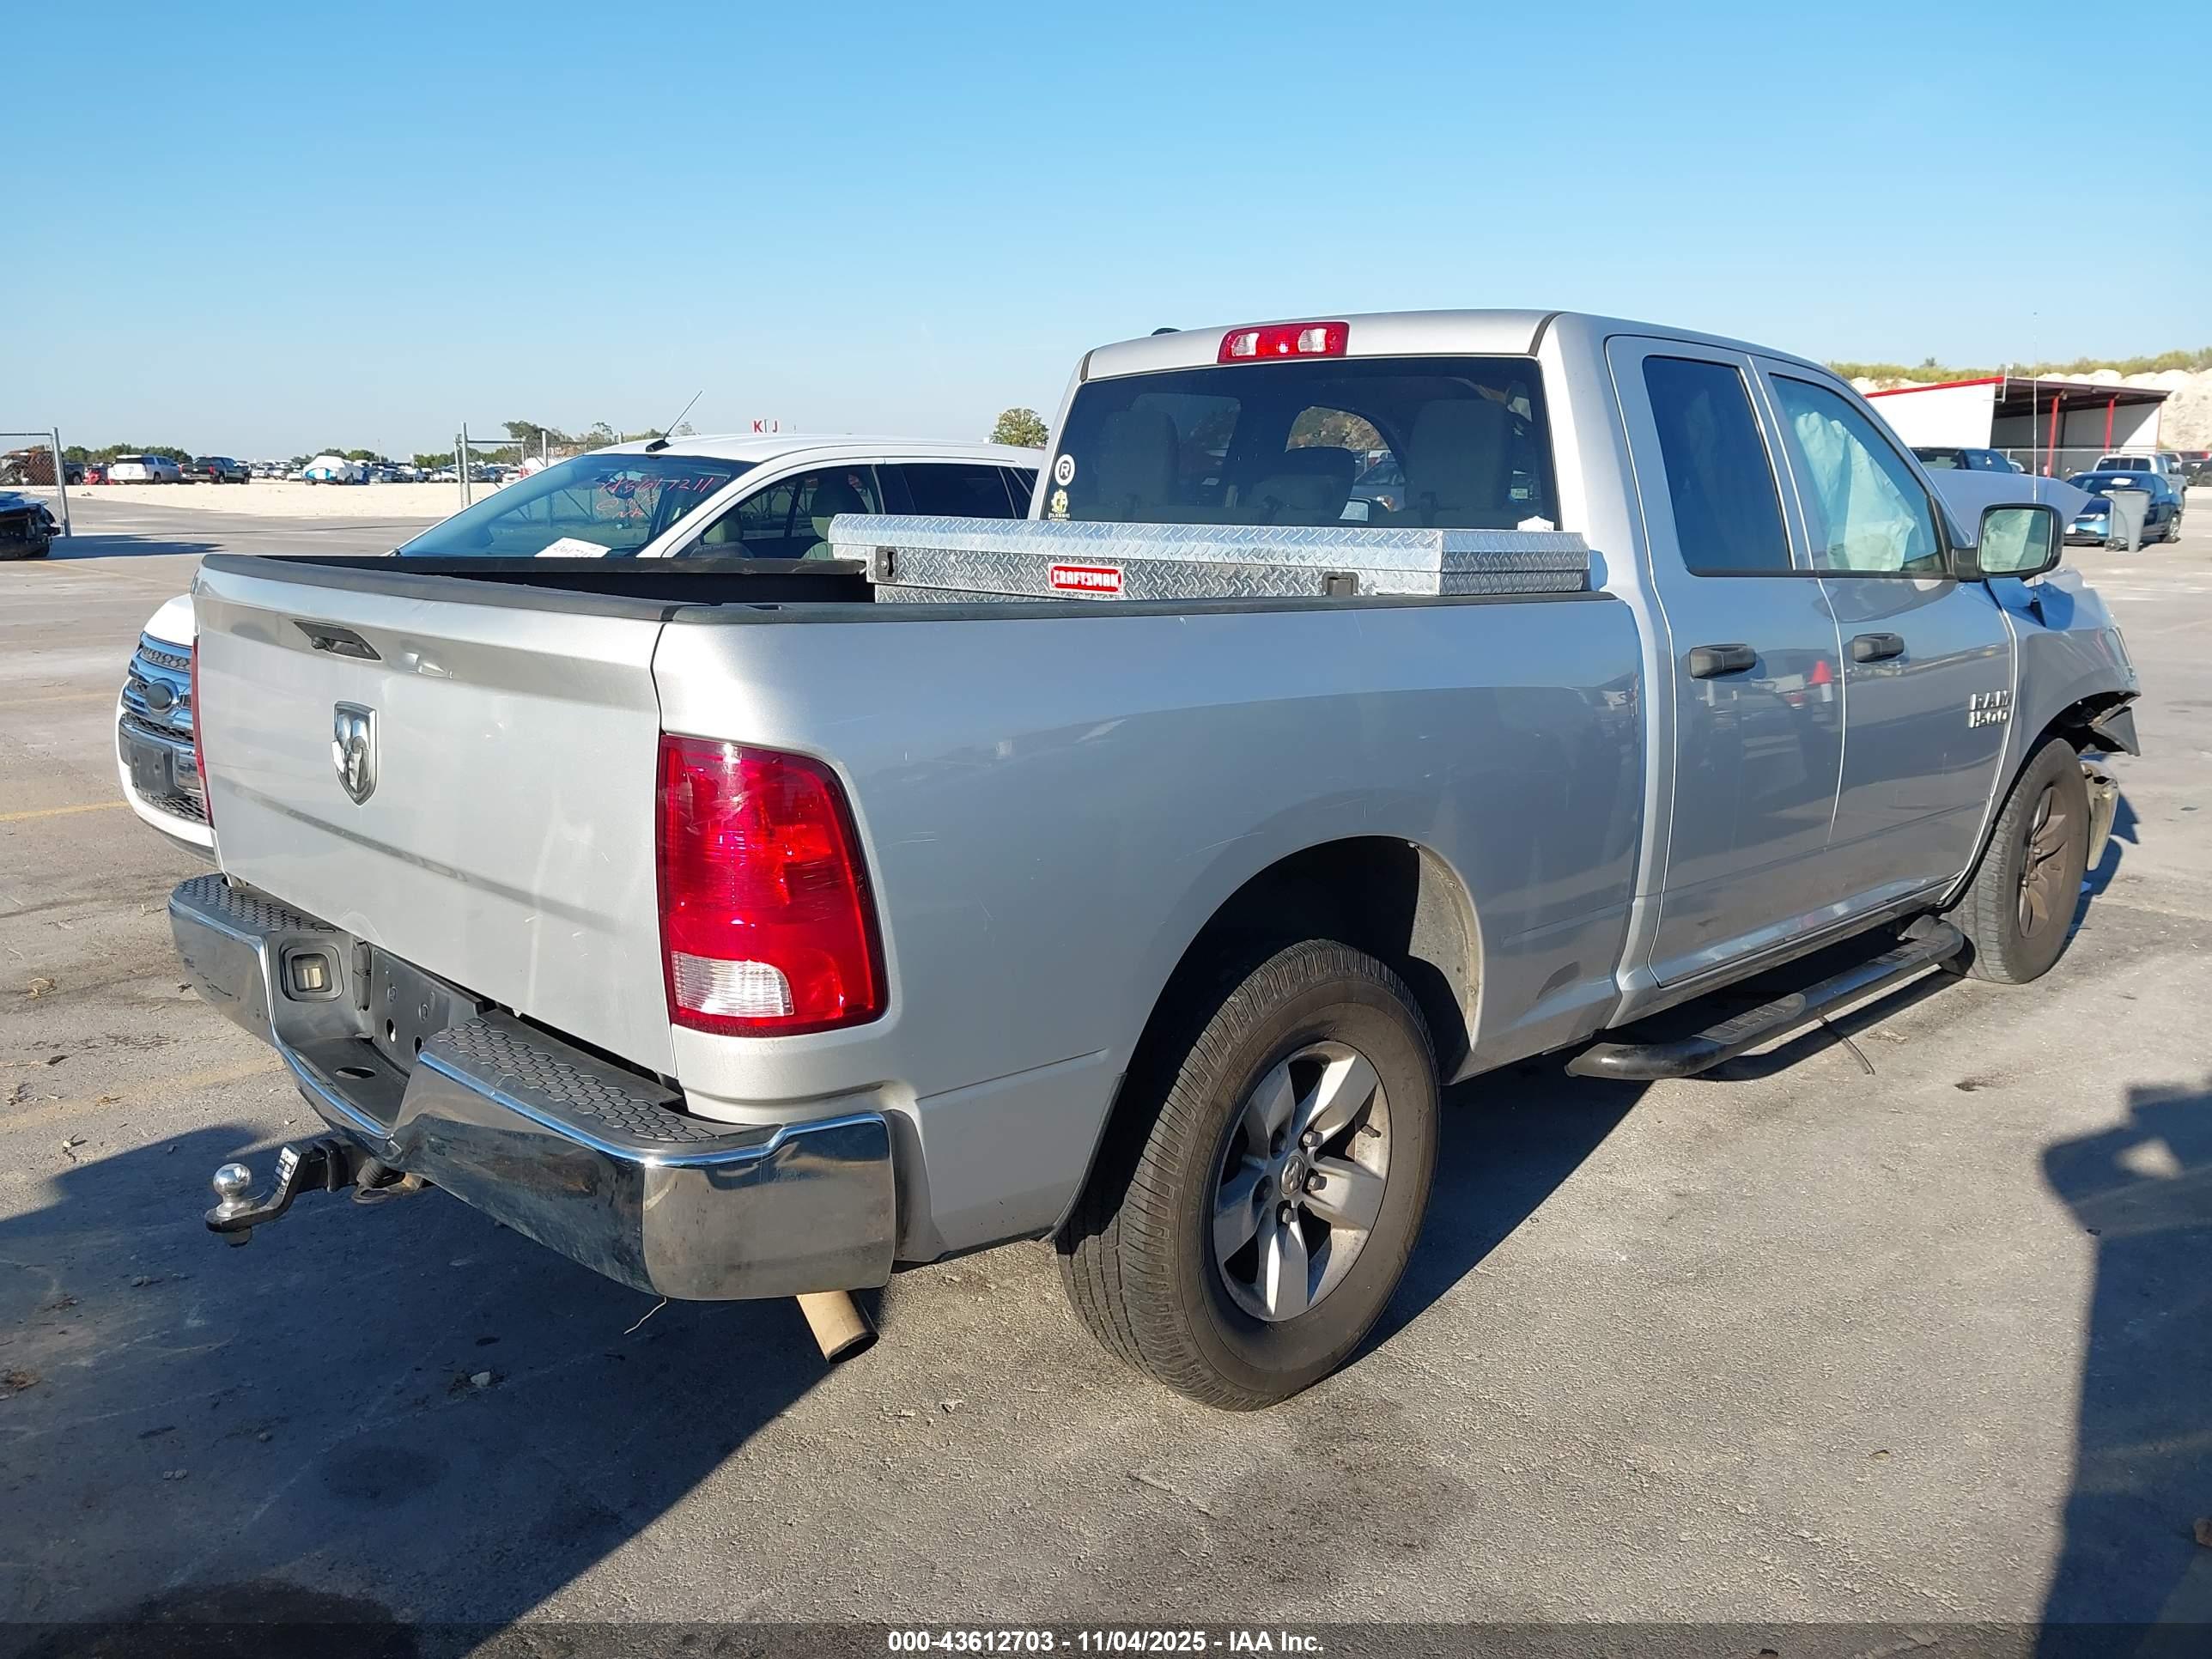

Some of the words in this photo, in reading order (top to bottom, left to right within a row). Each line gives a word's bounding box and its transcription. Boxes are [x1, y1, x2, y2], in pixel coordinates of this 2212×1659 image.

[753, 420, 763, 433] K
[772, 420, 778, 433] J
[1054, 570, 1118, 587] CRAFTSMAN
[1970, 690, 2009, 711] RAM
